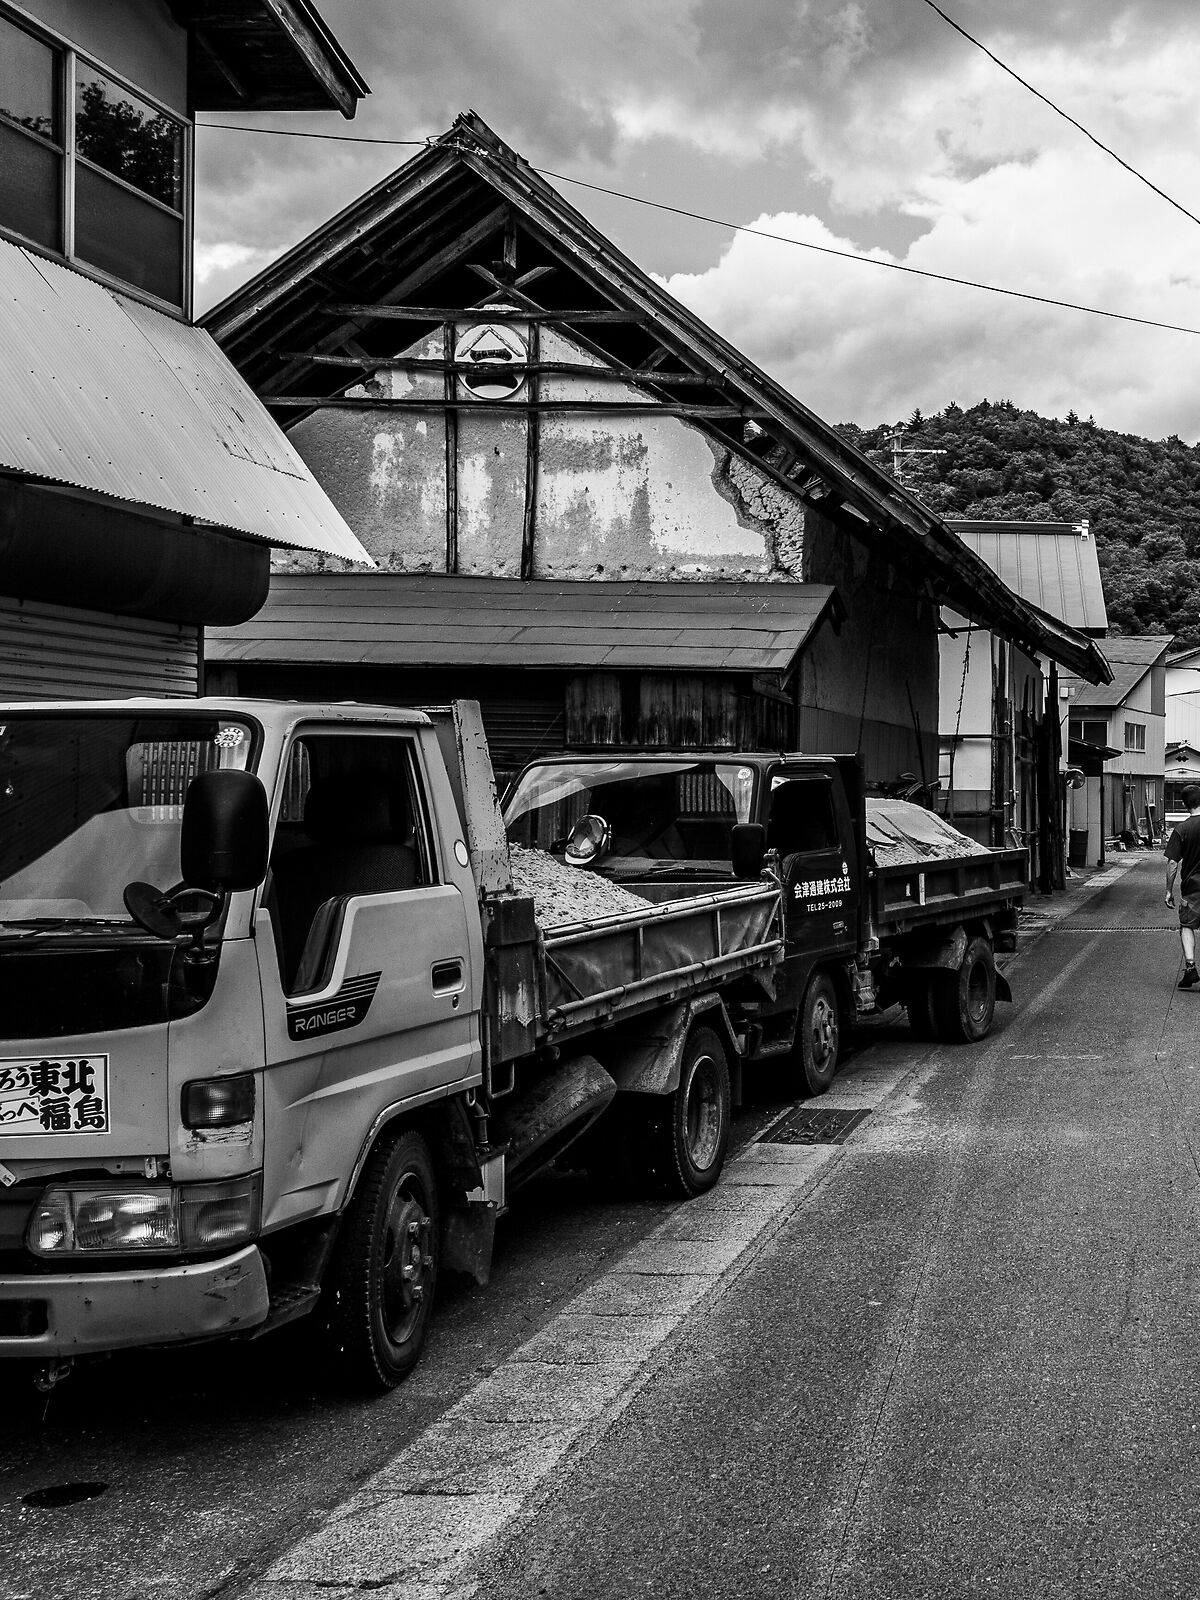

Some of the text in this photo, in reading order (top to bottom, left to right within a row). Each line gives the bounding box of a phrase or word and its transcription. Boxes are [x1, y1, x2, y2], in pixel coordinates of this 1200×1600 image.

[794, 876, 851, 899] 会津通建株式会社
[295, 1006, 356, 1033] RANGER
